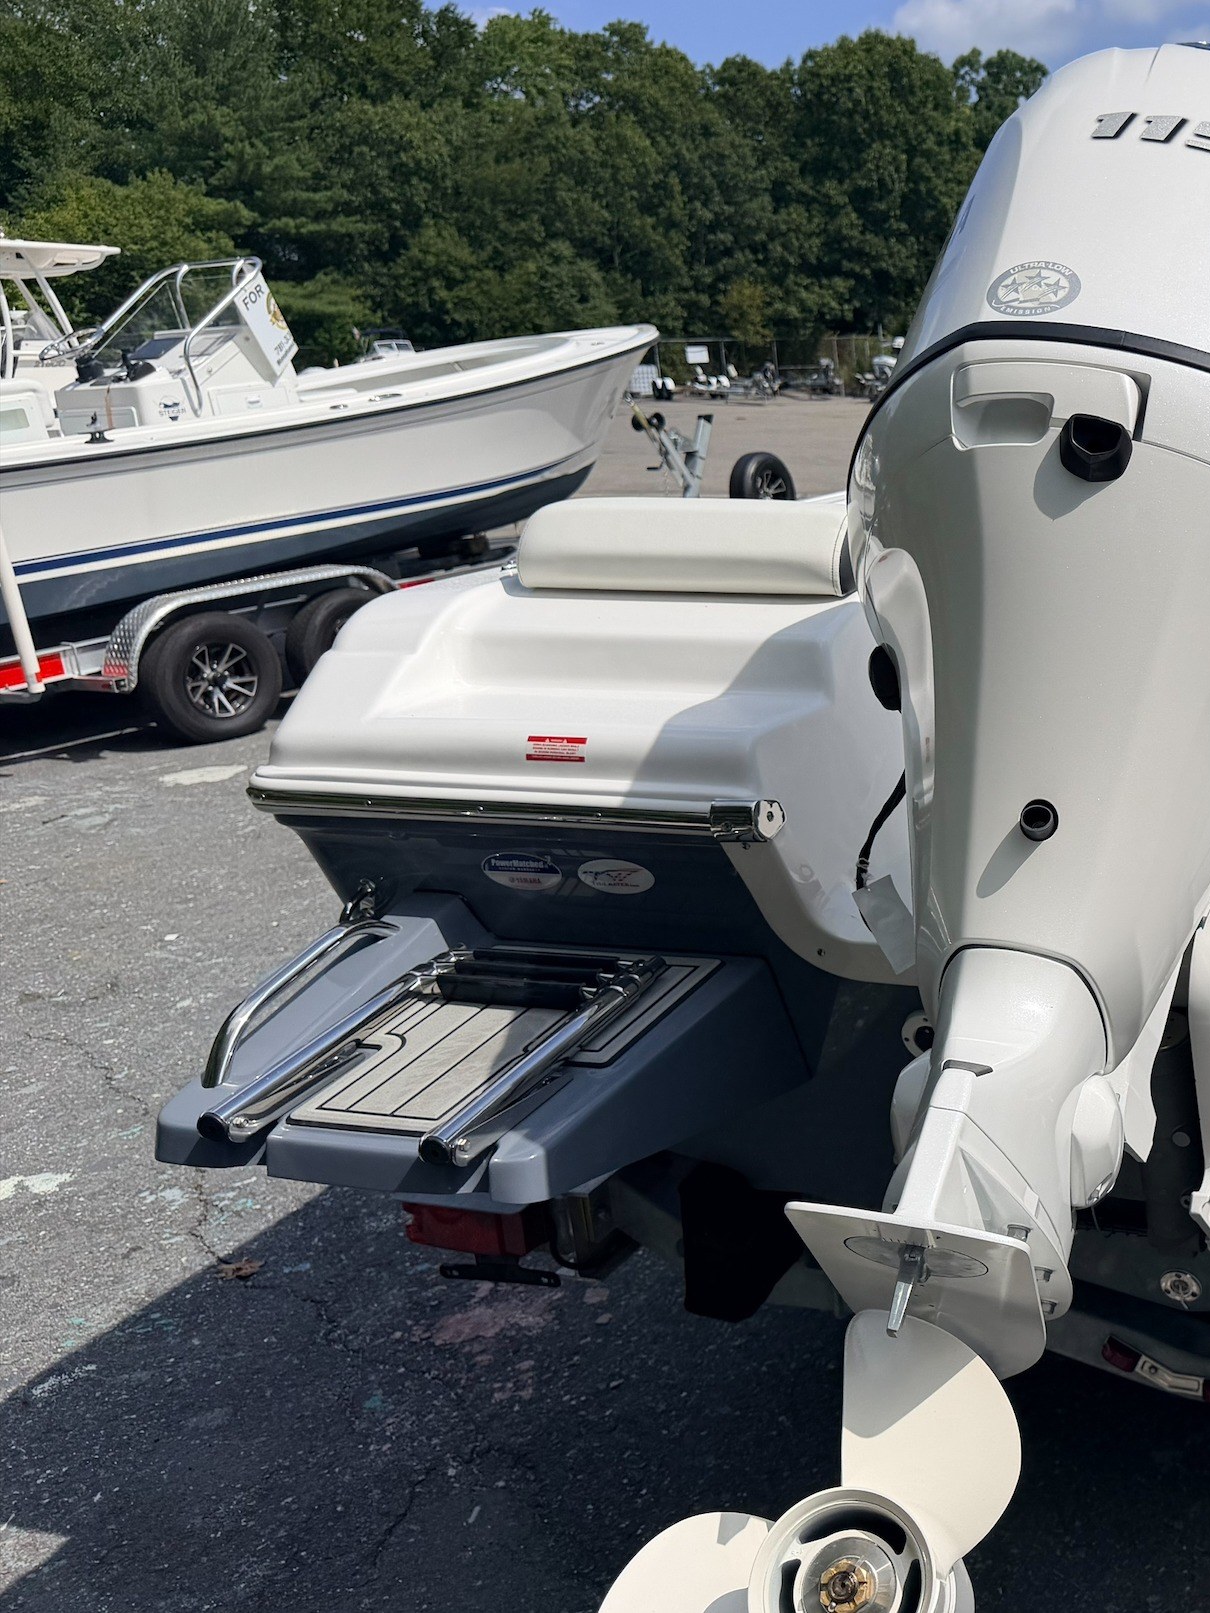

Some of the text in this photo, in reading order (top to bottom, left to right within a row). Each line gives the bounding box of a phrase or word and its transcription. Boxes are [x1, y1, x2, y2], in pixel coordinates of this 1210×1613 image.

[1009, 261, 1073, 276] ULTRA LOW
[242, 284, 265, 311] FOR
[1000, 305, 1051, 315] EMISSION
